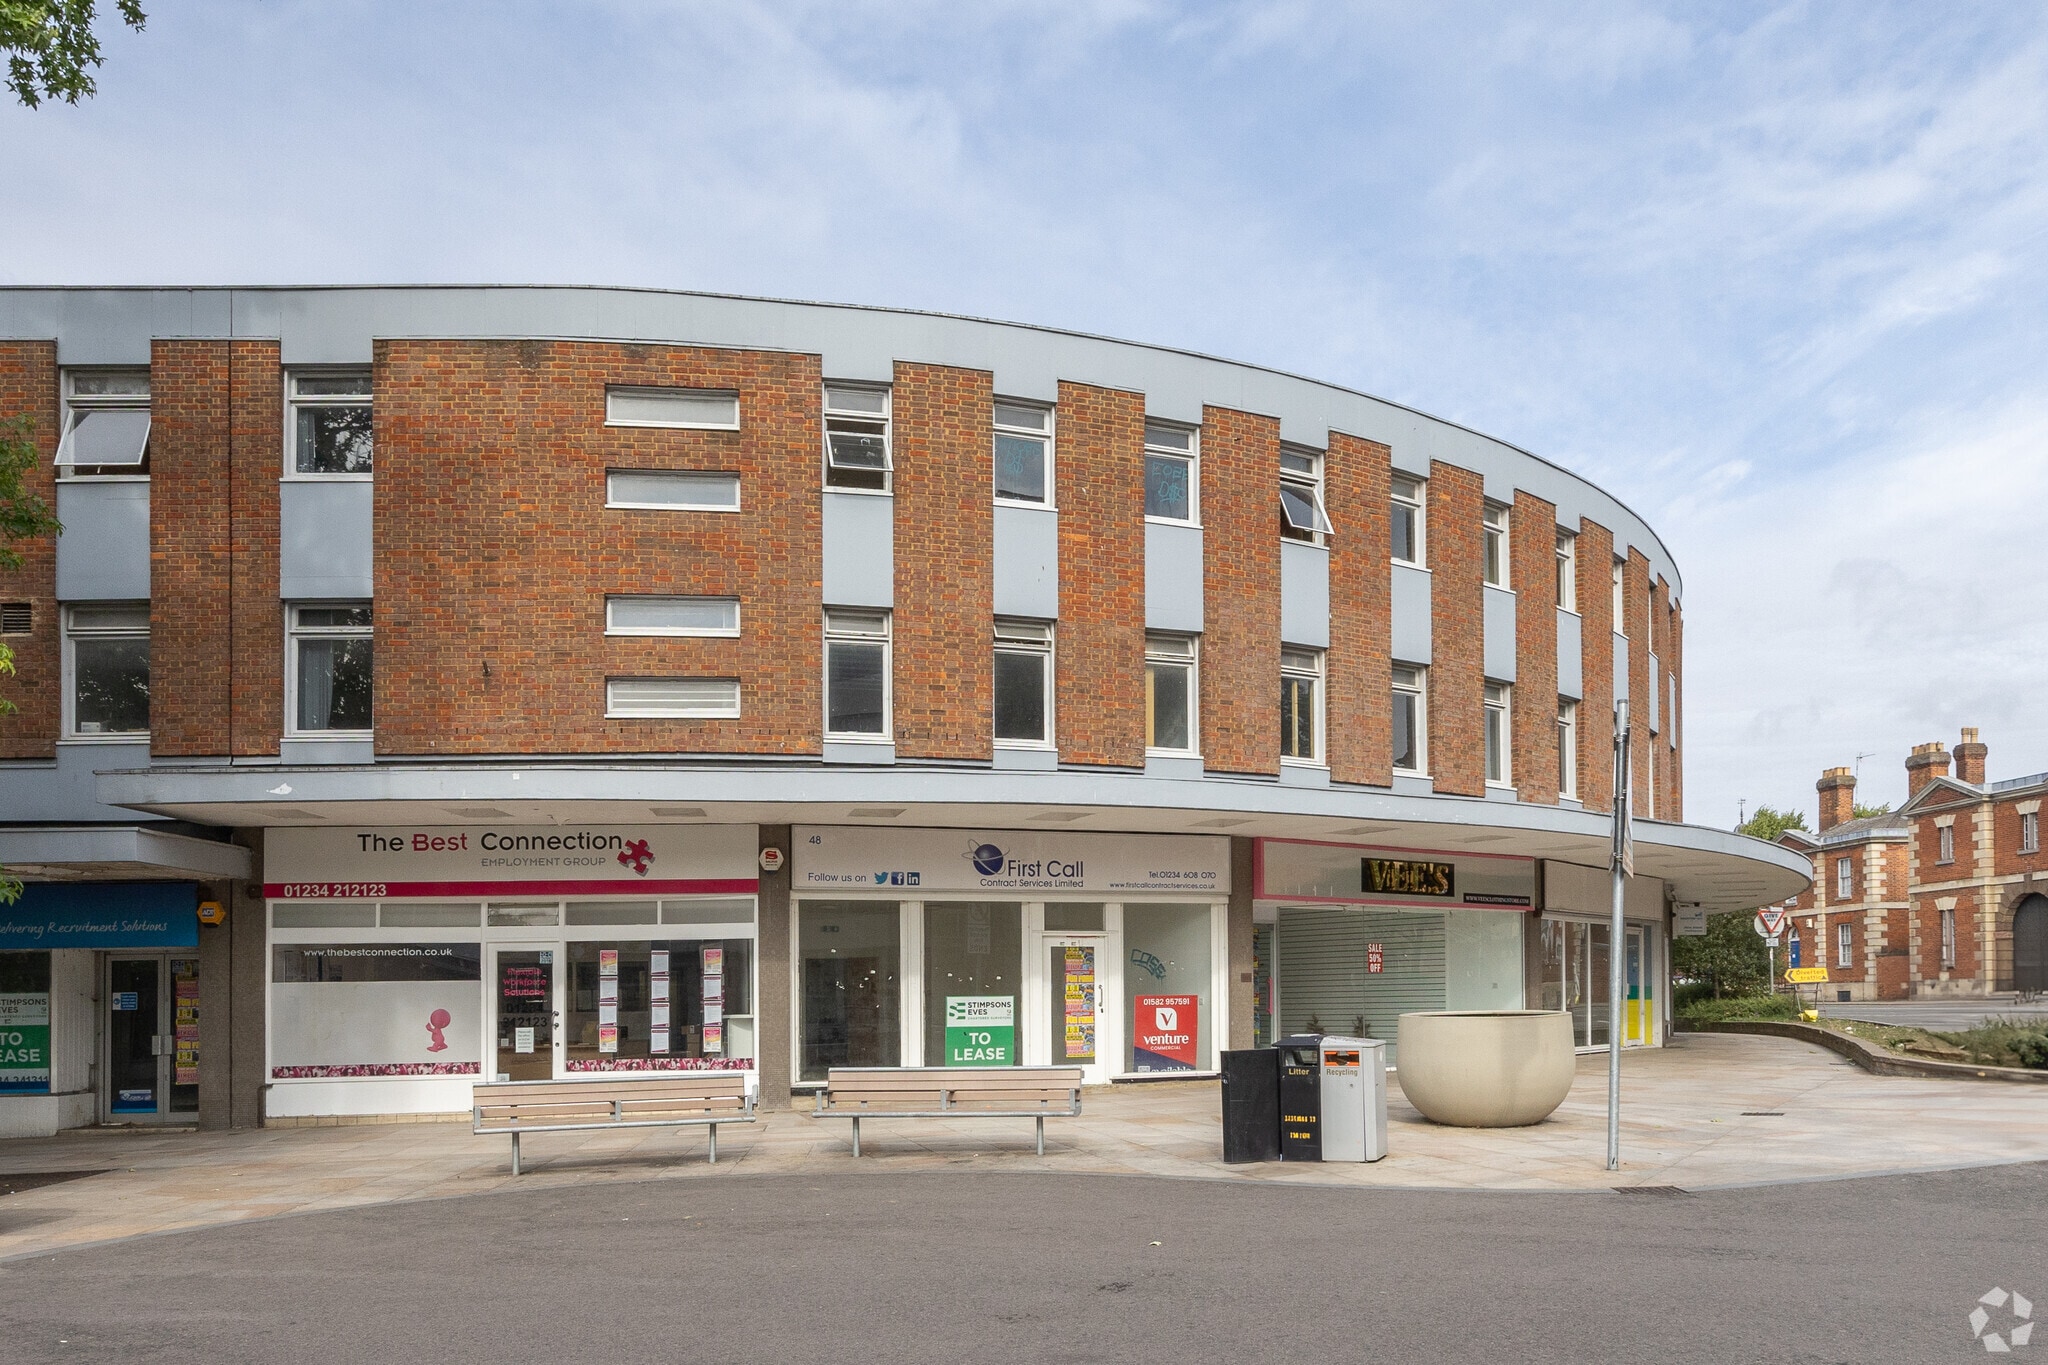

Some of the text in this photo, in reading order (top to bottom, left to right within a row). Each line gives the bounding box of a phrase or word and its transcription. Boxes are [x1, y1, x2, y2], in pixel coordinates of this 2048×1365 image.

[357, 831, 622, 851] The Best Connection
[808, 835, 822, 845] 48
[481, 857, 606, 867] EMPLOYMENT GROUP
[1007, 860, 1084, 878] First Call
[807, 872, 839, 882] Follow
[841, 874, 852, 882] us
[1183, 871, 1199, 879] 608
[1200, 871, 1217, 879] 070
[980, 878, 1084, 888] Contract Services Limited
[284, 884, 387, 897] 01234 212123
[48, 920, 119, 933] Recruitment
[121, 919, 168, 932] Solutions
[303, 948, 453, 958] www.thebestconnection.co.uk
[1367, 943, 1383, 953] SALE
[1368, 953, 1382, 963] 50%
[1369, 963, 1382, 973] OFF
[967, 1001, 1012, 1009] STIMPSONS
[1143, 997, 1190, 1006] 01582 957591
[967, 1008, 988, 1016] EVES
[968, 1031, 991, 1045] TO
[1143, 1033, 1190, 1045] venture
[954, 1047, 1006, 1061] LEASE
[1326, 1068, 1358, 1077] Recycling
